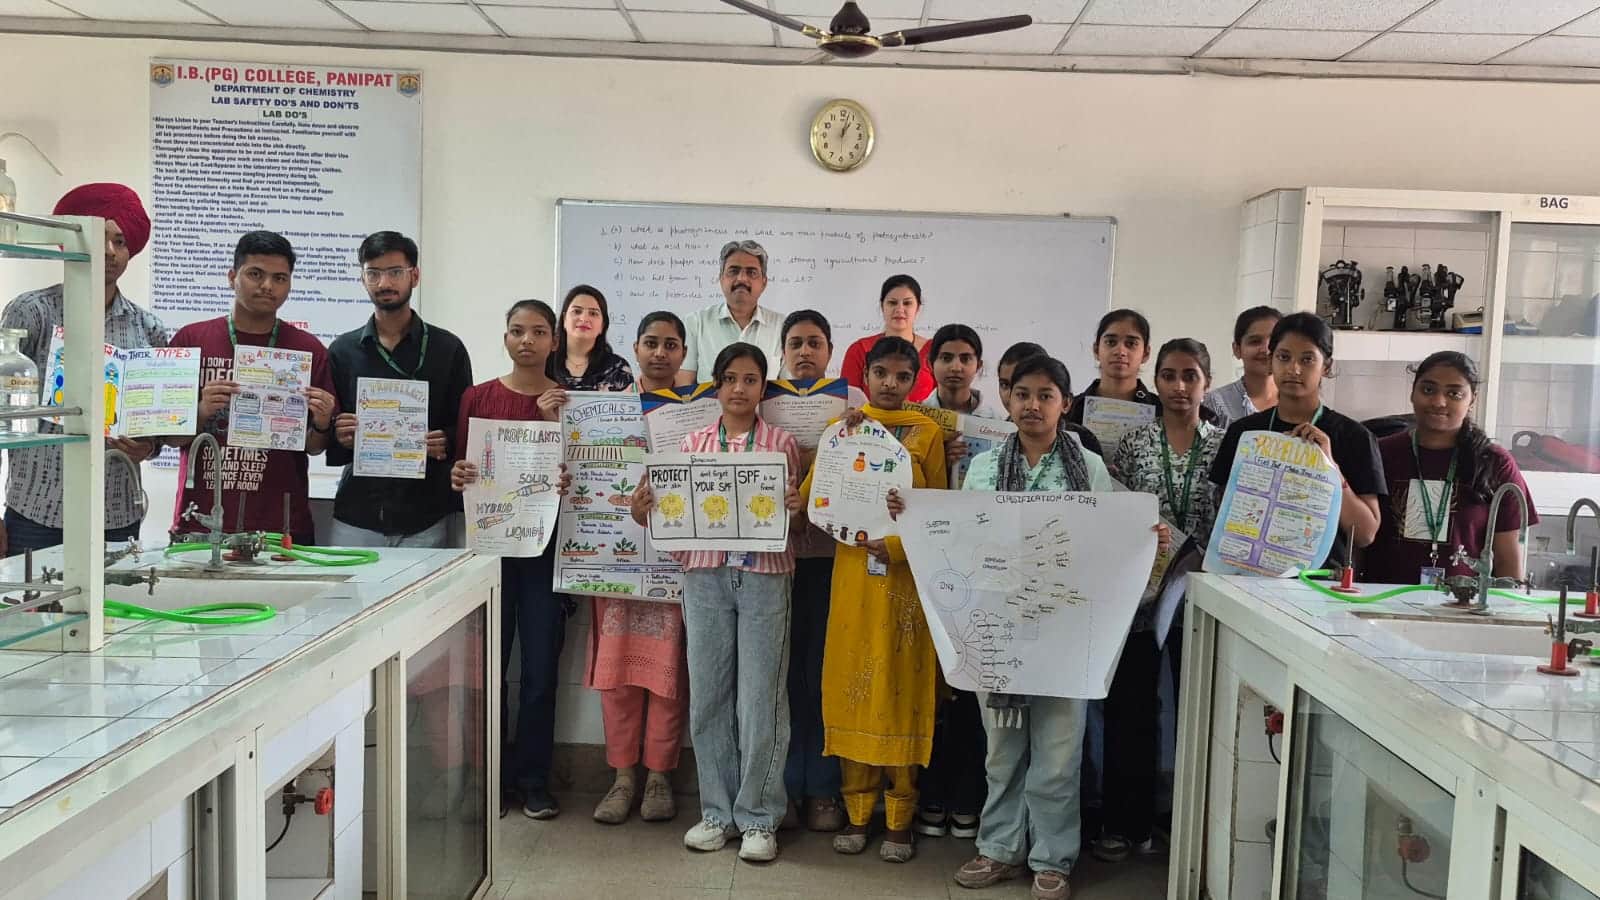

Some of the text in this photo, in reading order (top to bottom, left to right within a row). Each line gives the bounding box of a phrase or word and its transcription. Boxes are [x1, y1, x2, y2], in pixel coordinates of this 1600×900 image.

[177, 66, 393, 87] I.B.(PG) COLLEGE, PANIPAT
[214, 84, 356, 98] DEPARTMENT OF CHEMISTRY
[211, 96, 359, 110] LAB SAFETY DO'S AND DON'TS
[262, 110, 308, 119] LAB DO'S
[1540, 197, 1569, 209] BAG
[155, 348, 192, 359] TYPES
[572, 402, 627, 422] CHEMICALS
[498, 427, 561, 443] PROPELLANTS
[240, 462, 267, 472] SLEEP
[243, 471, 264, 482] EVEN
[518, 472, 549, 485] SOLID
[651, 468, 689, 483] PROTECT
[738, 469, 761, 485] SPF
[223, 481, 236, 490] MY
[236, 481, 260, 491] ROOM
[695, 481, 733, 493] YOUR SPF
[1064, 494, 1075, 502] OF
[476, 501, 513, 516] HYBRID
